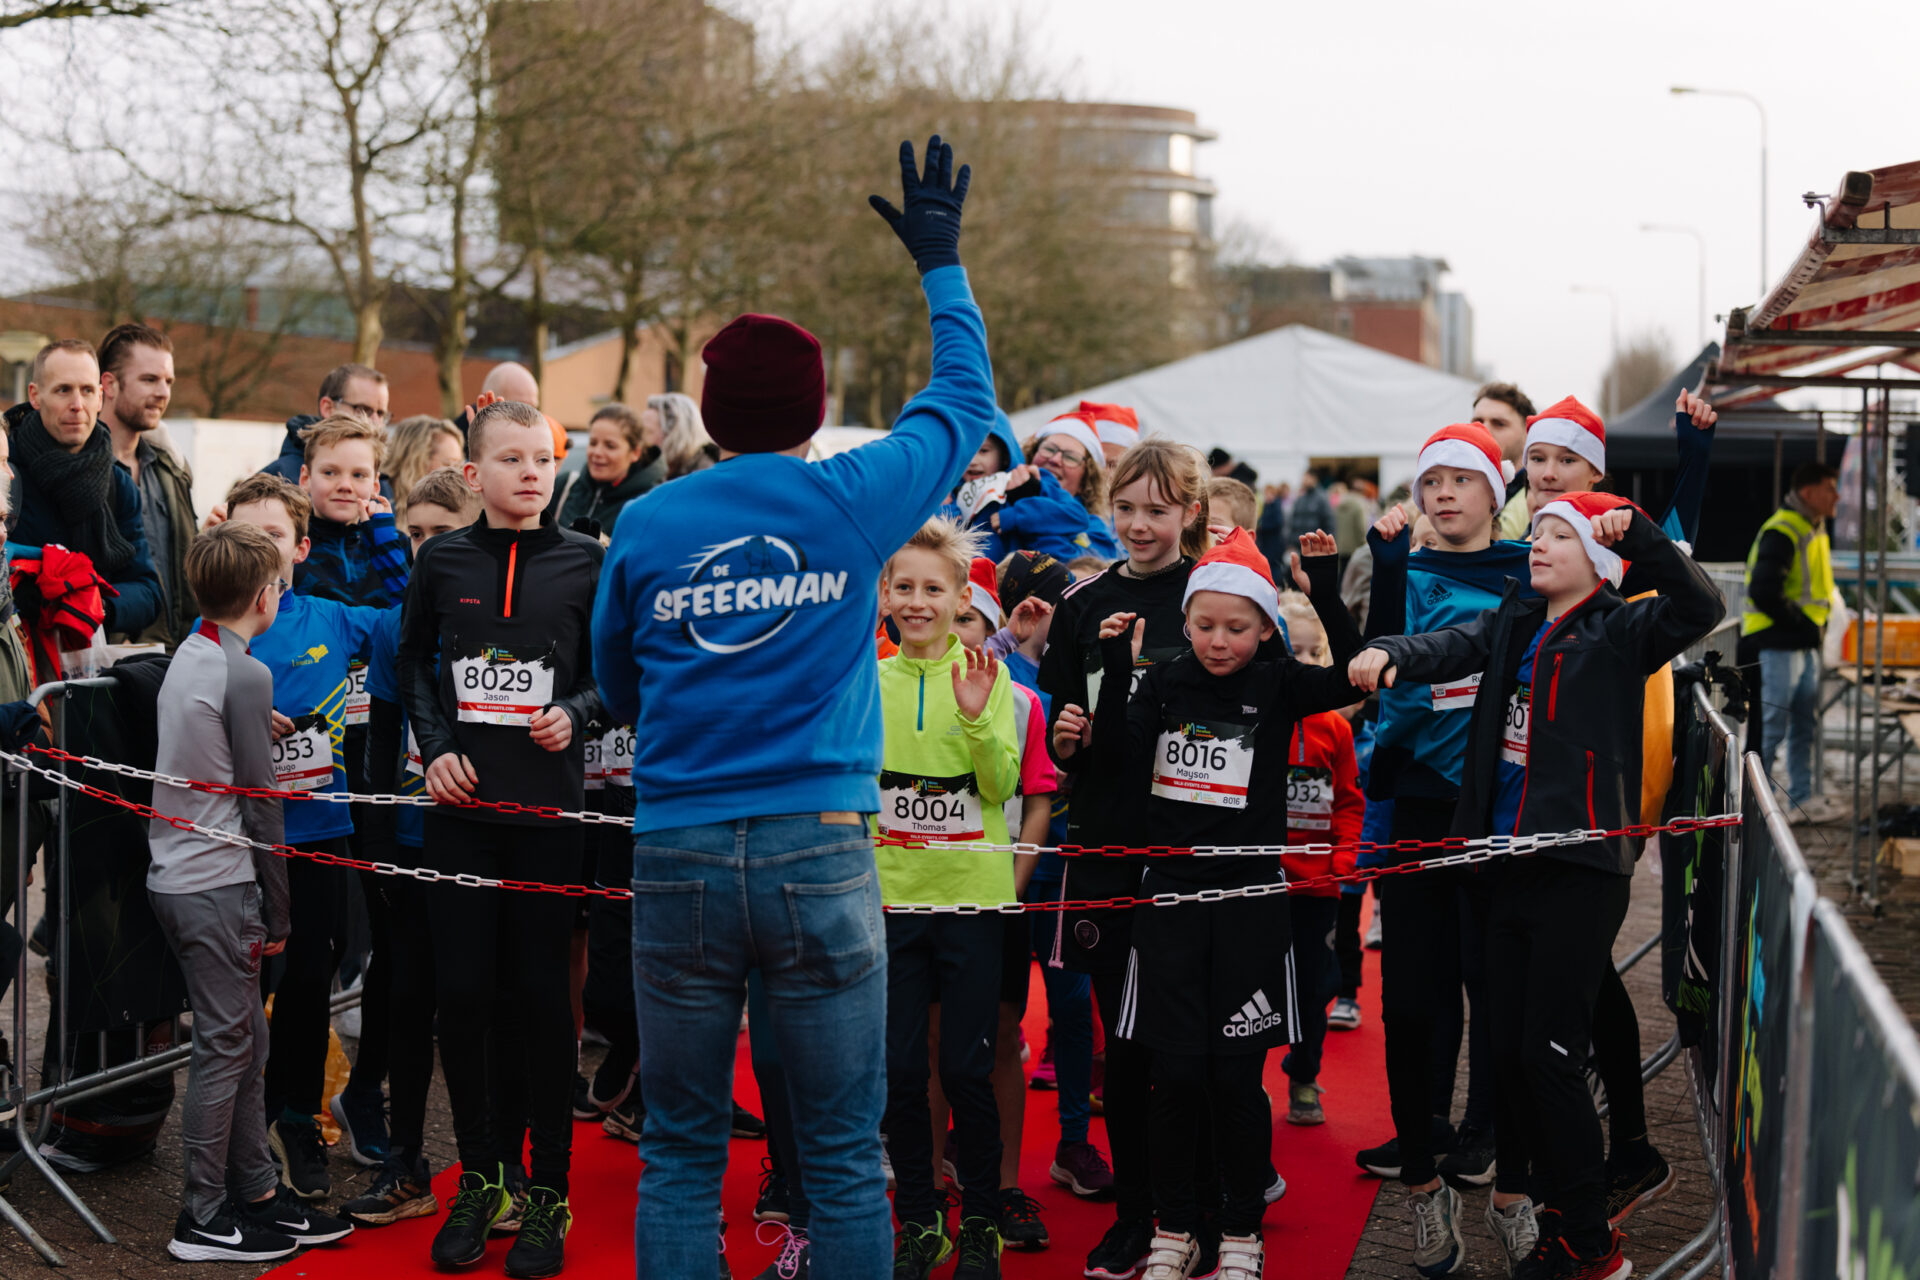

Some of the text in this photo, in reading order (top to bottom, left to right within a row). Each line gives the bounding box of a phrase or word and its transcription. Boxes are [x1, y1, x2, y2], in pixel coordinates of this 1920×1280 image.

[712, 564, 730, 577] DE
[653, 570, 848, 622] SFEERMAN
[464, 666, 532, 692] 8029
[484, 693, 509, 702] Jason
[1506, 703, 1530, 729] 80
[1166, 741, 1227, 771] 8016
[275, 763, 296, 774] Hugo
[1176, 768, 1209, 780] Mayson
[1223, 796, 1240, 806] 8016
[1286, 783, 1321, 804] 032
[894, 796, 965, 821] 8004
[912, 822, 947, 832] Thomas
[1223, 1012, 1281, 1038] adidas
